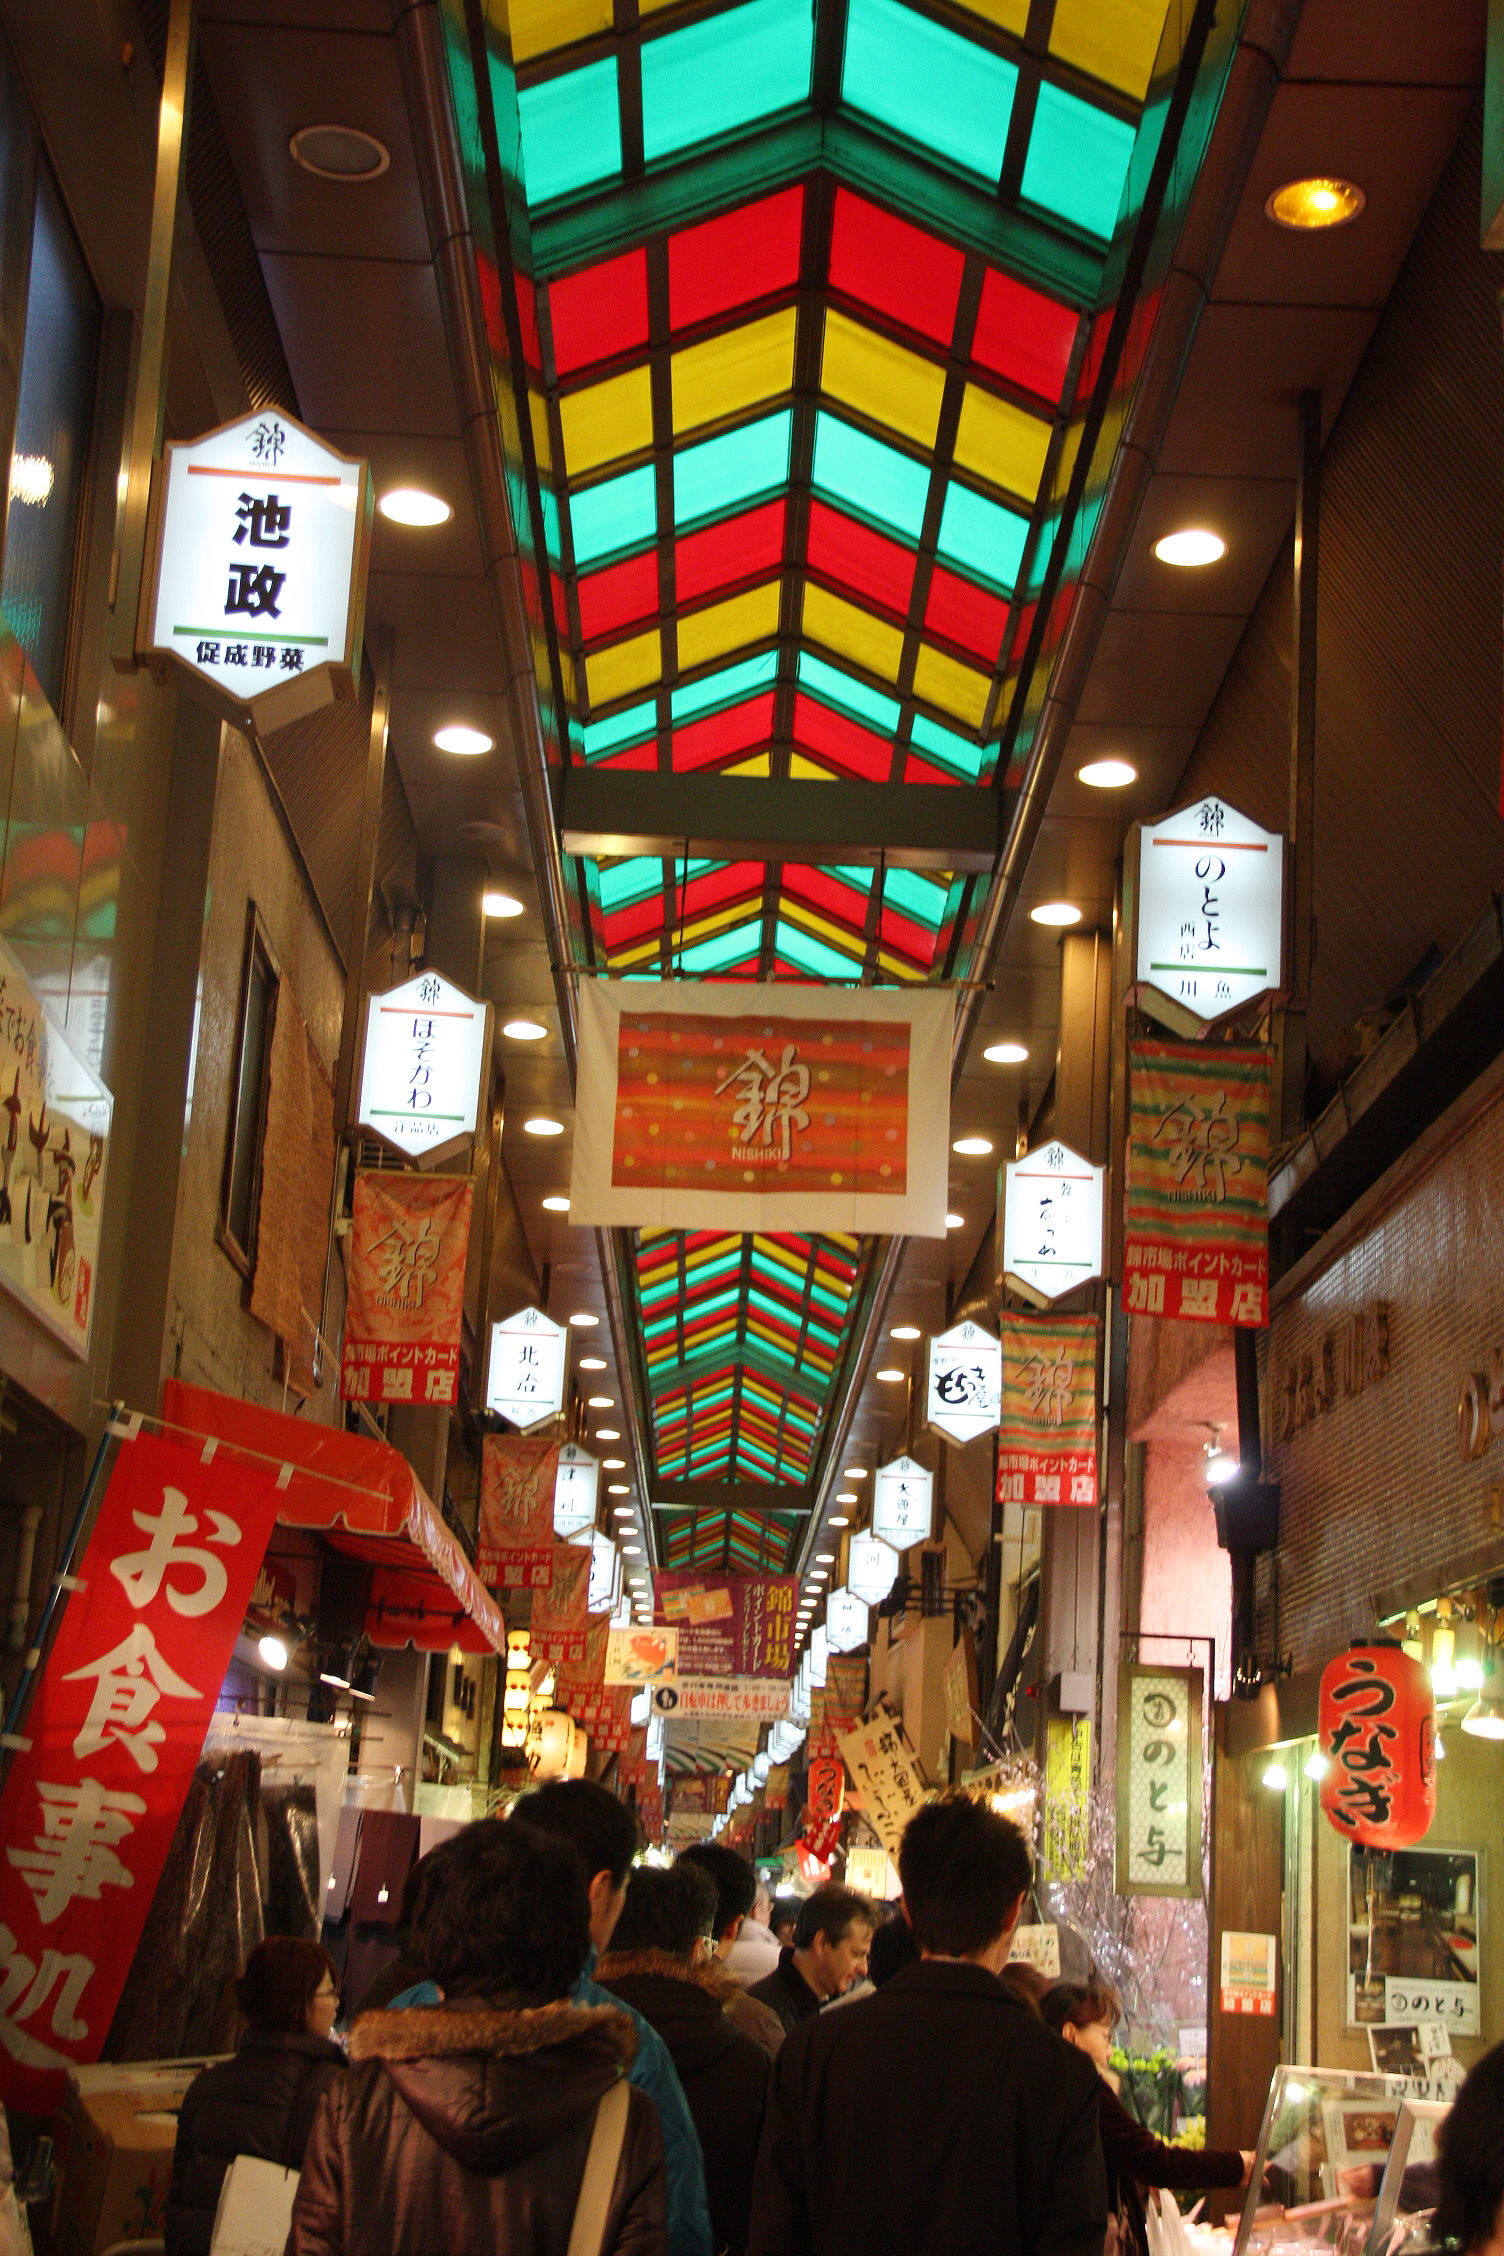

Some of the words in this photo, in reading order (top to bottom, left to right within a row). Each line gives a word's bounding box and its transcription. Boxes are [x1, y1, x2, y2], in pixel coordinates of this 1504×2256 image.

[224, 492, 292, 620] 池政
[196, 640, 305, 672] 促成野菜
[1194, 855, 1226, 951] のとよ
[406, 1018, 437, 1109] ほそかわ
[714, 1043, 811, 1162] 錦
[730, 1146, 783, 1161] NISHIKI
[1154, 1090, 1243, 1203] 錦
[368, 1216, 441, 1310] 錦
[1126, 1245, 1266, 1277] 錦市場ポイントカード
[1127, 1271, 1263, 1323] 加盟店
[343, 1364, 457, 1401] 加盟店
[999, 1470, 1095, 1505] 加盟店
[764, 1584, 792, 1672] 錦市場
[0, 1485, 243, 2068] お食事処
[1332, 1658, 1398, 1828] うなぎ
